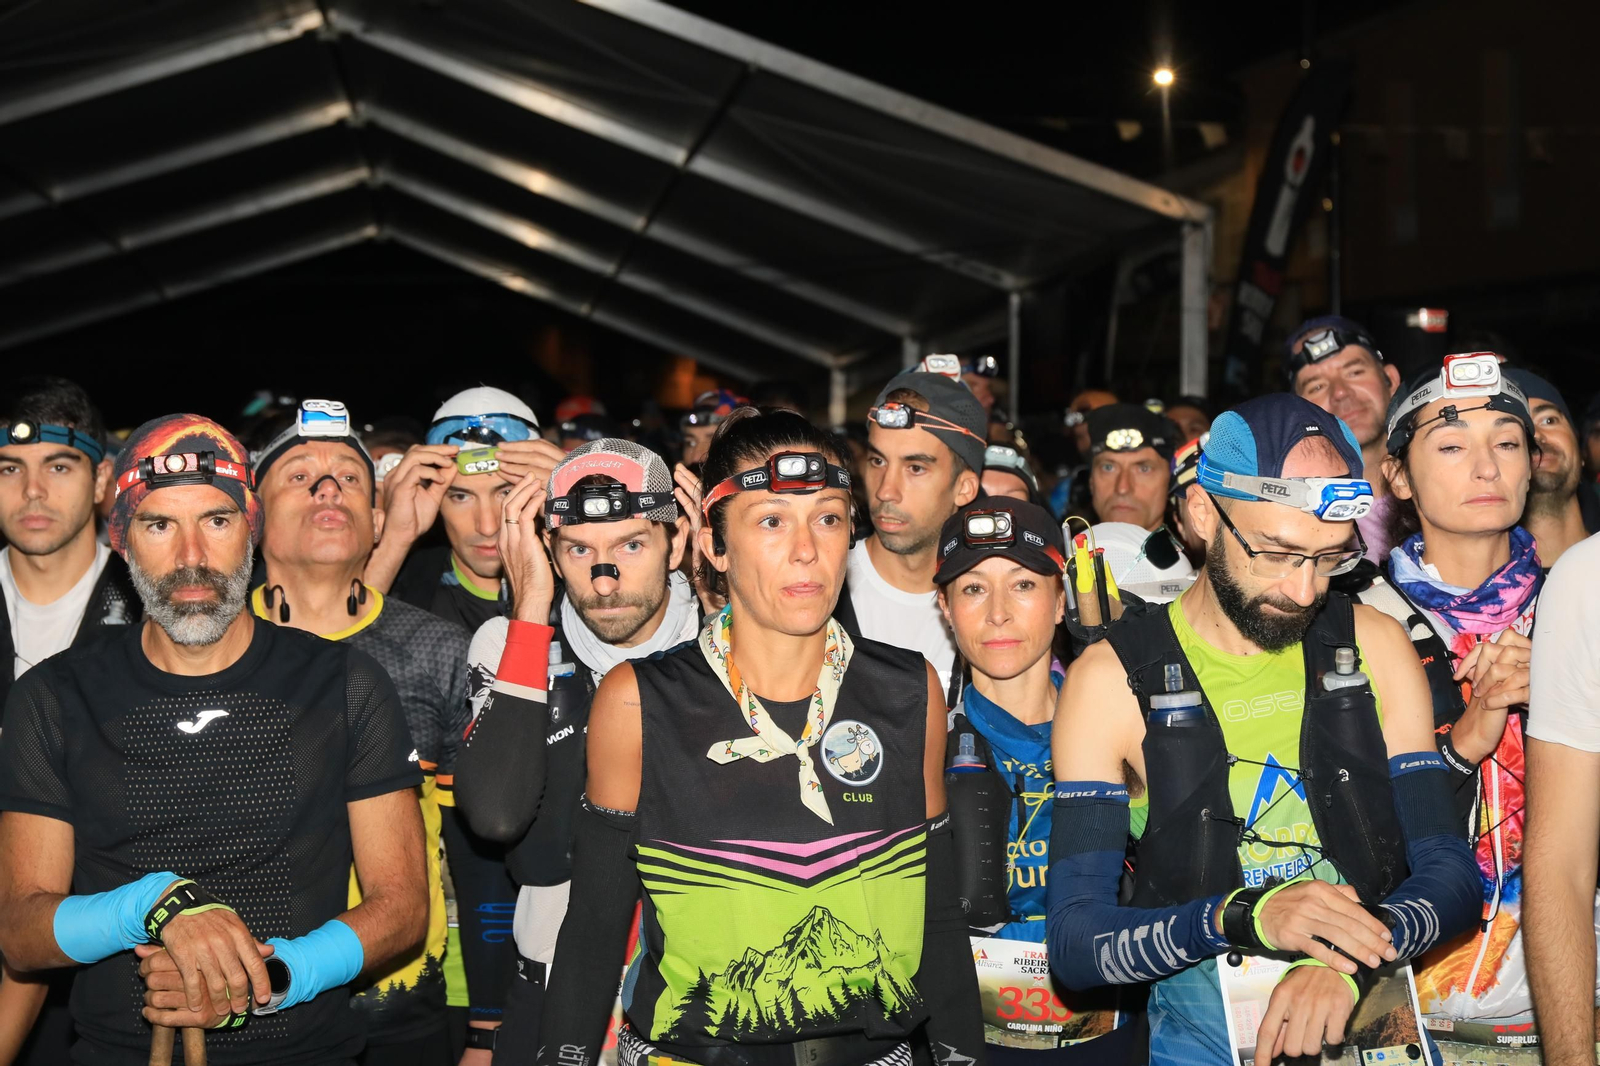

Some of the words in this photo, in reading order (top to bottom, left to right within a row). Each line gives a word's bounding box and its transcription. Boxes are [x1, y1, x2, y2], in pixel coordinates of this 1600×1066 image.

[1411, 388, 1432, 405] PETZL
[743, 473, 767, 488] PETZL
[1261, 482, 1290, 497] PETZL
[553, 500, 569, 511] PETZL
[639, 496, 656, 509] PETZL
[1024, 532, 1044, 546] PETZL
[944, 538, 958, 556] PETZL
[1161, 585, 1183, 595] PETZL
[843, 792, 873, 803] CLUB
[1007, 1022, 1042, 1033] CAROLINA
[1044, 1022, 1063, 1033] NIÑO
[1496, 1035, 1539, 1044] SUPERLUZ
